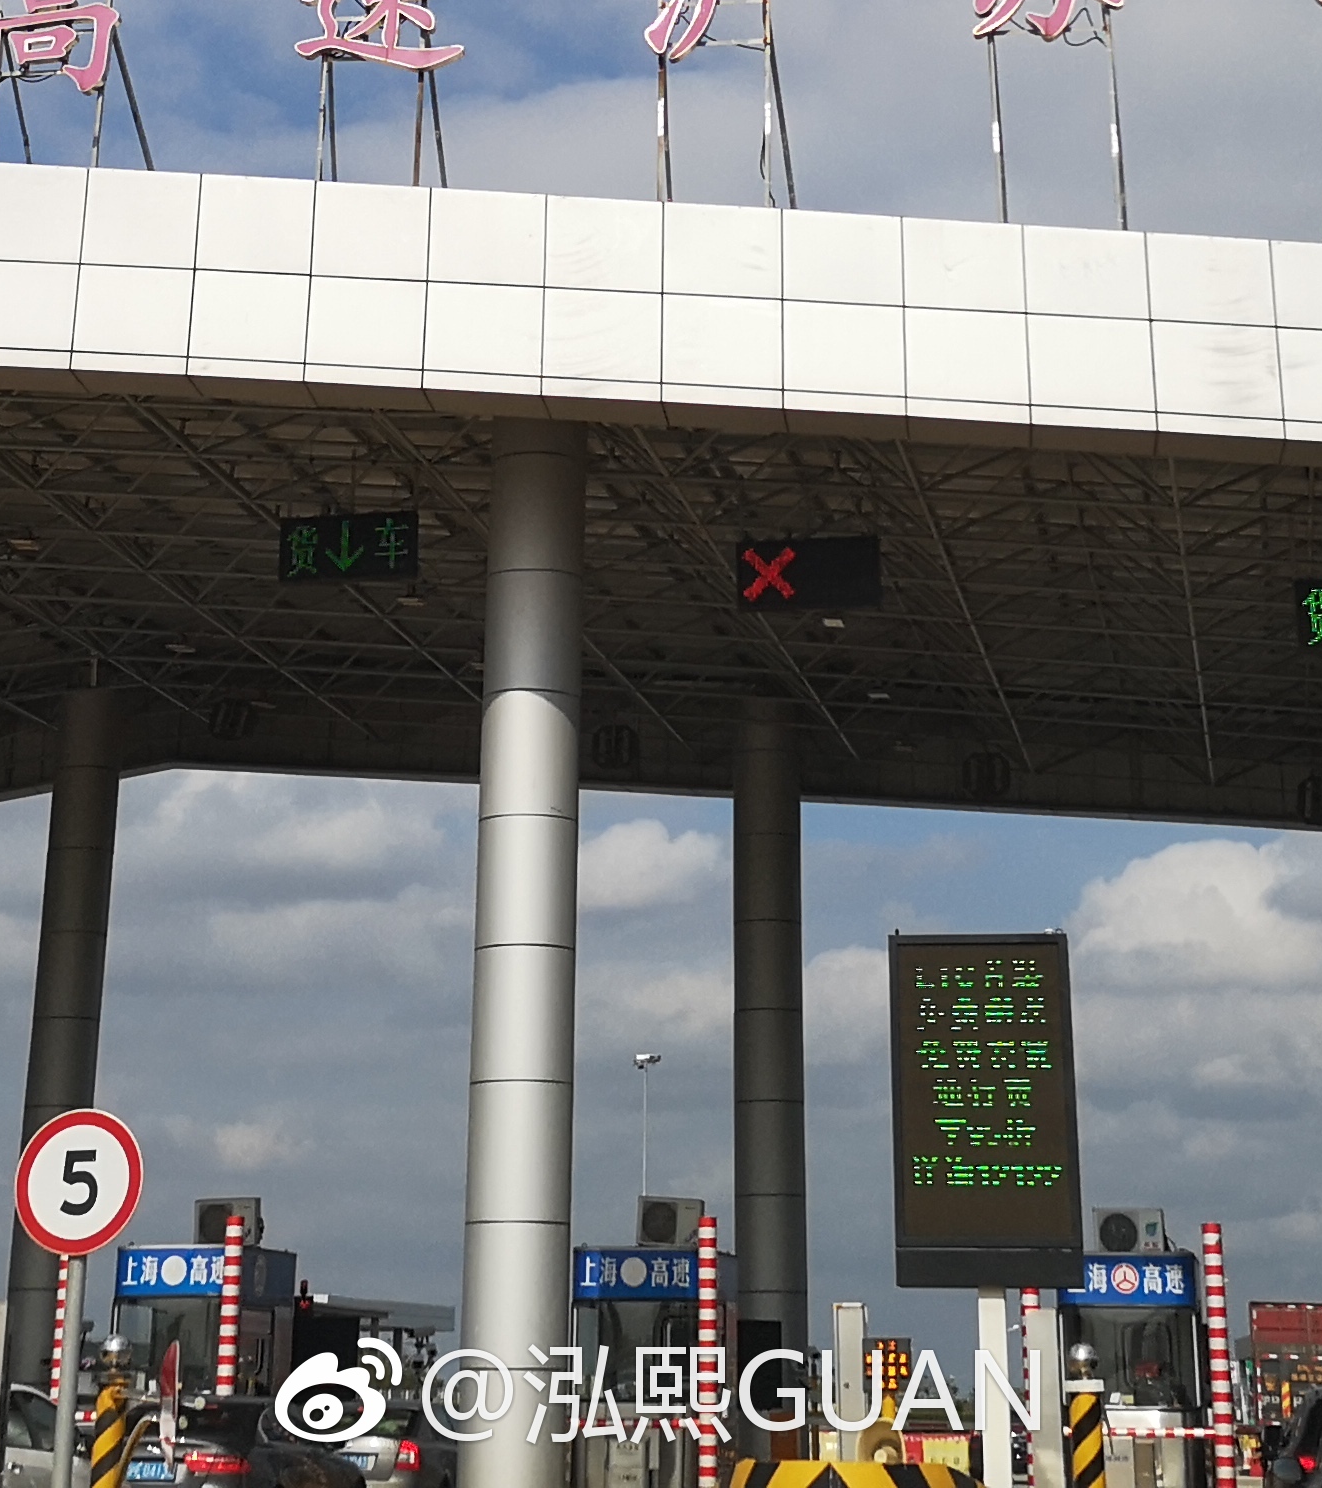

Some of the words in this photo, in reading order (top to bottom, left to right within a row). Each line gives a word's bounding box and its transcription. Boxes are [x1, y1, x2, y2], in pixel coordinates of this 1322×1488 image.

[60, 1149, 98, 1216] 5
[121, 1255, 159, 1286] 上海
[580, 1256, 618, 1287] 上海
[650, 1257, 691, 1288] 高速
[1142, 1263, 1185, 1295] 高速
